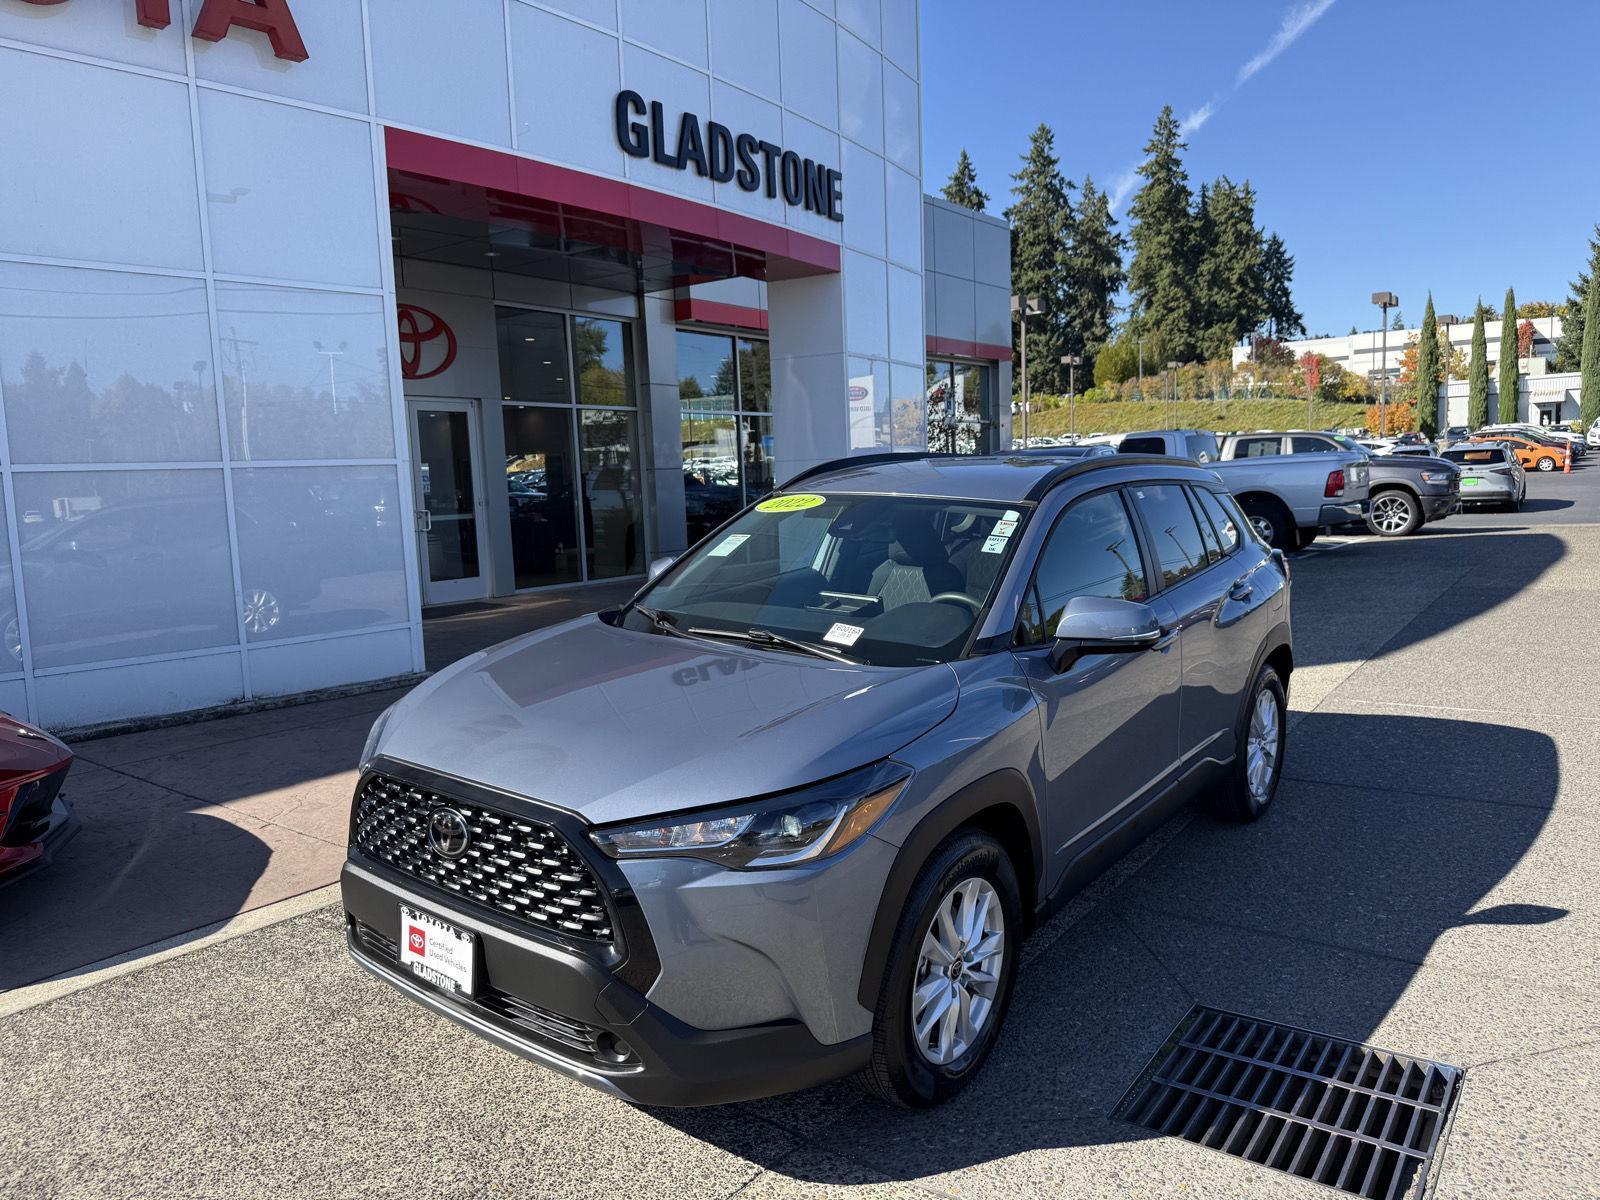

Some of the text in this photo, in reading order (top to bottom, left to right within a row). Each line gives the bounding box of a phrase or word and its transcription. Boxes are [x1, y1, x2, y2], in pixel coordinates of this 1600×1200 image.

[616, 89, 844, 222] GLADSTONE
[415, 911, 456, 937] TOYOTA
[429, 938, 454, 955] Certified
[429, 949, 444, 961] Used
[413, 960, 456, 992] GLADSTONE
